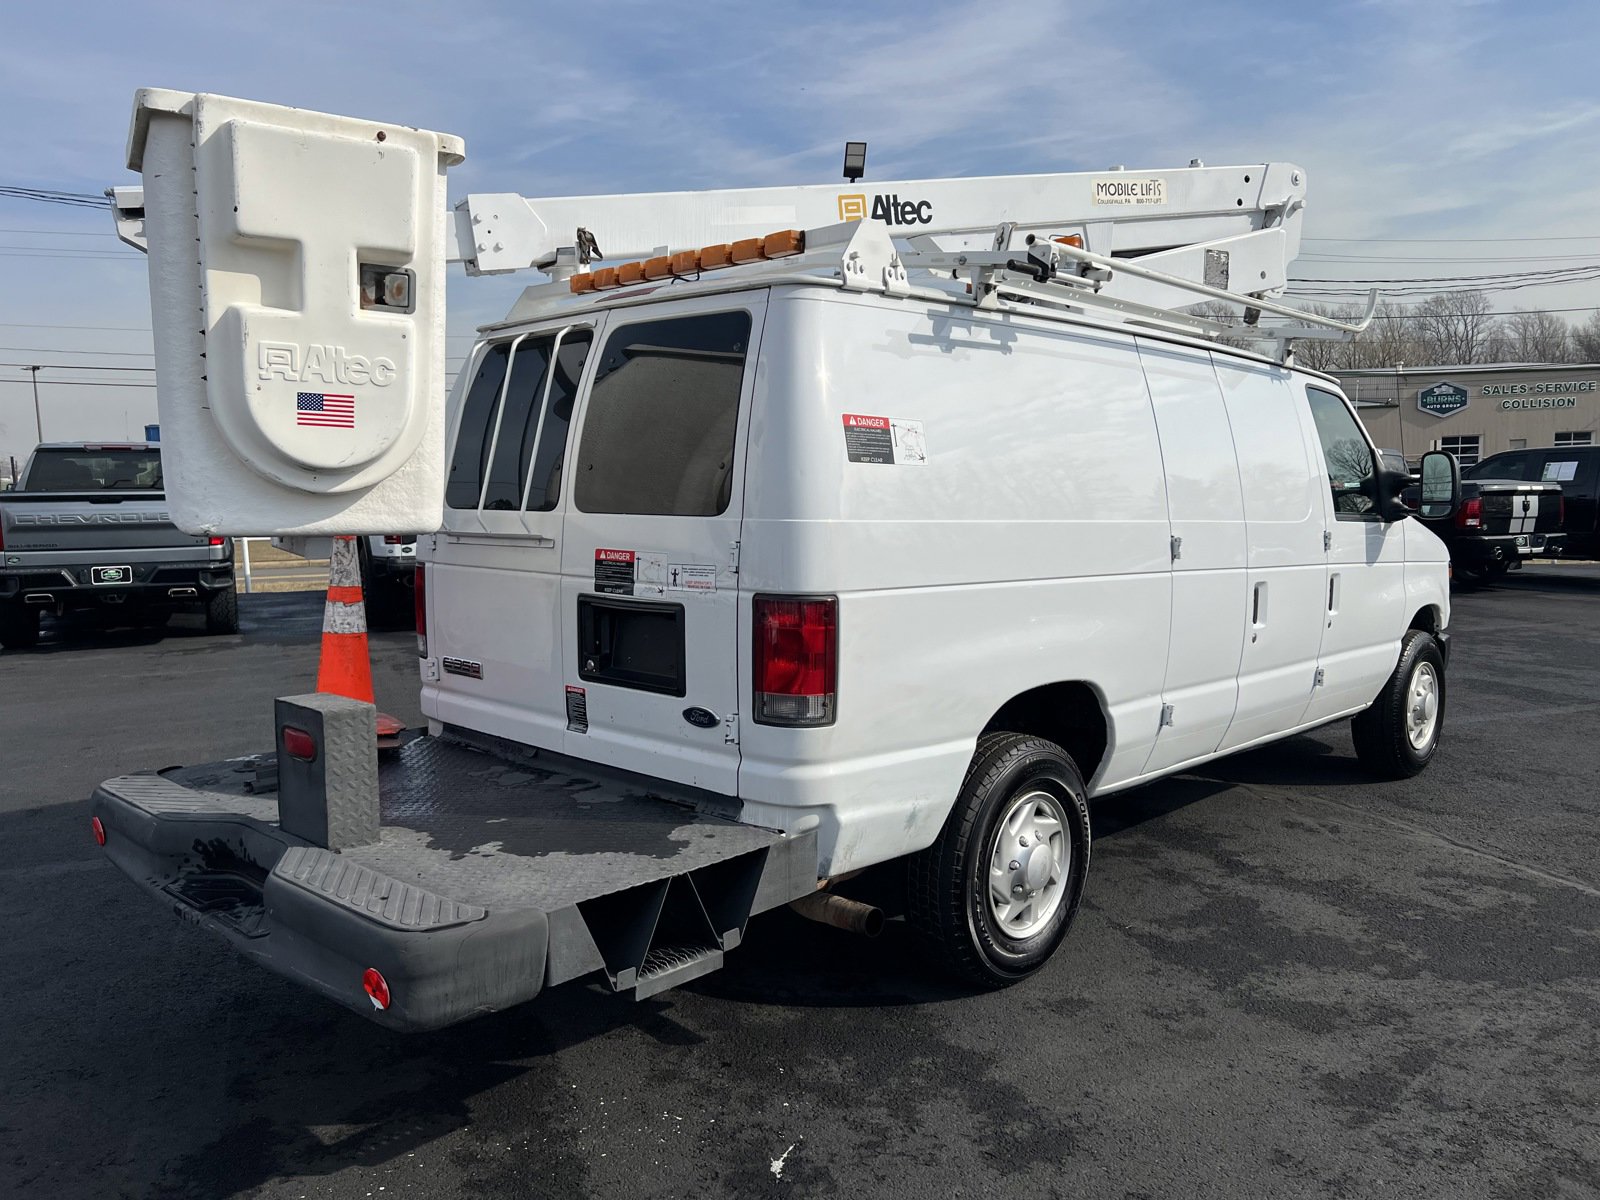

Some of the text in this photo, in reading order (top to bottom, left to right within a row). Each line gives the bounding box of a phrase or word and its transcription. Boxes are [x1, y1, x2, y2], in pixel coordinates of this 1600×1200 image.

[1096, 180, 1162, 196] MOBILE LIFTS
[871, 194, 933, 226] Altec
[301, 344, 396, 387] Altec
[1483, 381, 1596, 395] SALES SERVICE
[1426, 395, 1462, 404] BURNS
[1502, 398, 1576, 410] COLLISION
[857, 417, 884, 427] DANGER
[15, 512, 170, 525] CHEVROLE
[606, 551, 631, 561] DANGER
[690, 709, 710, 724] Ford
